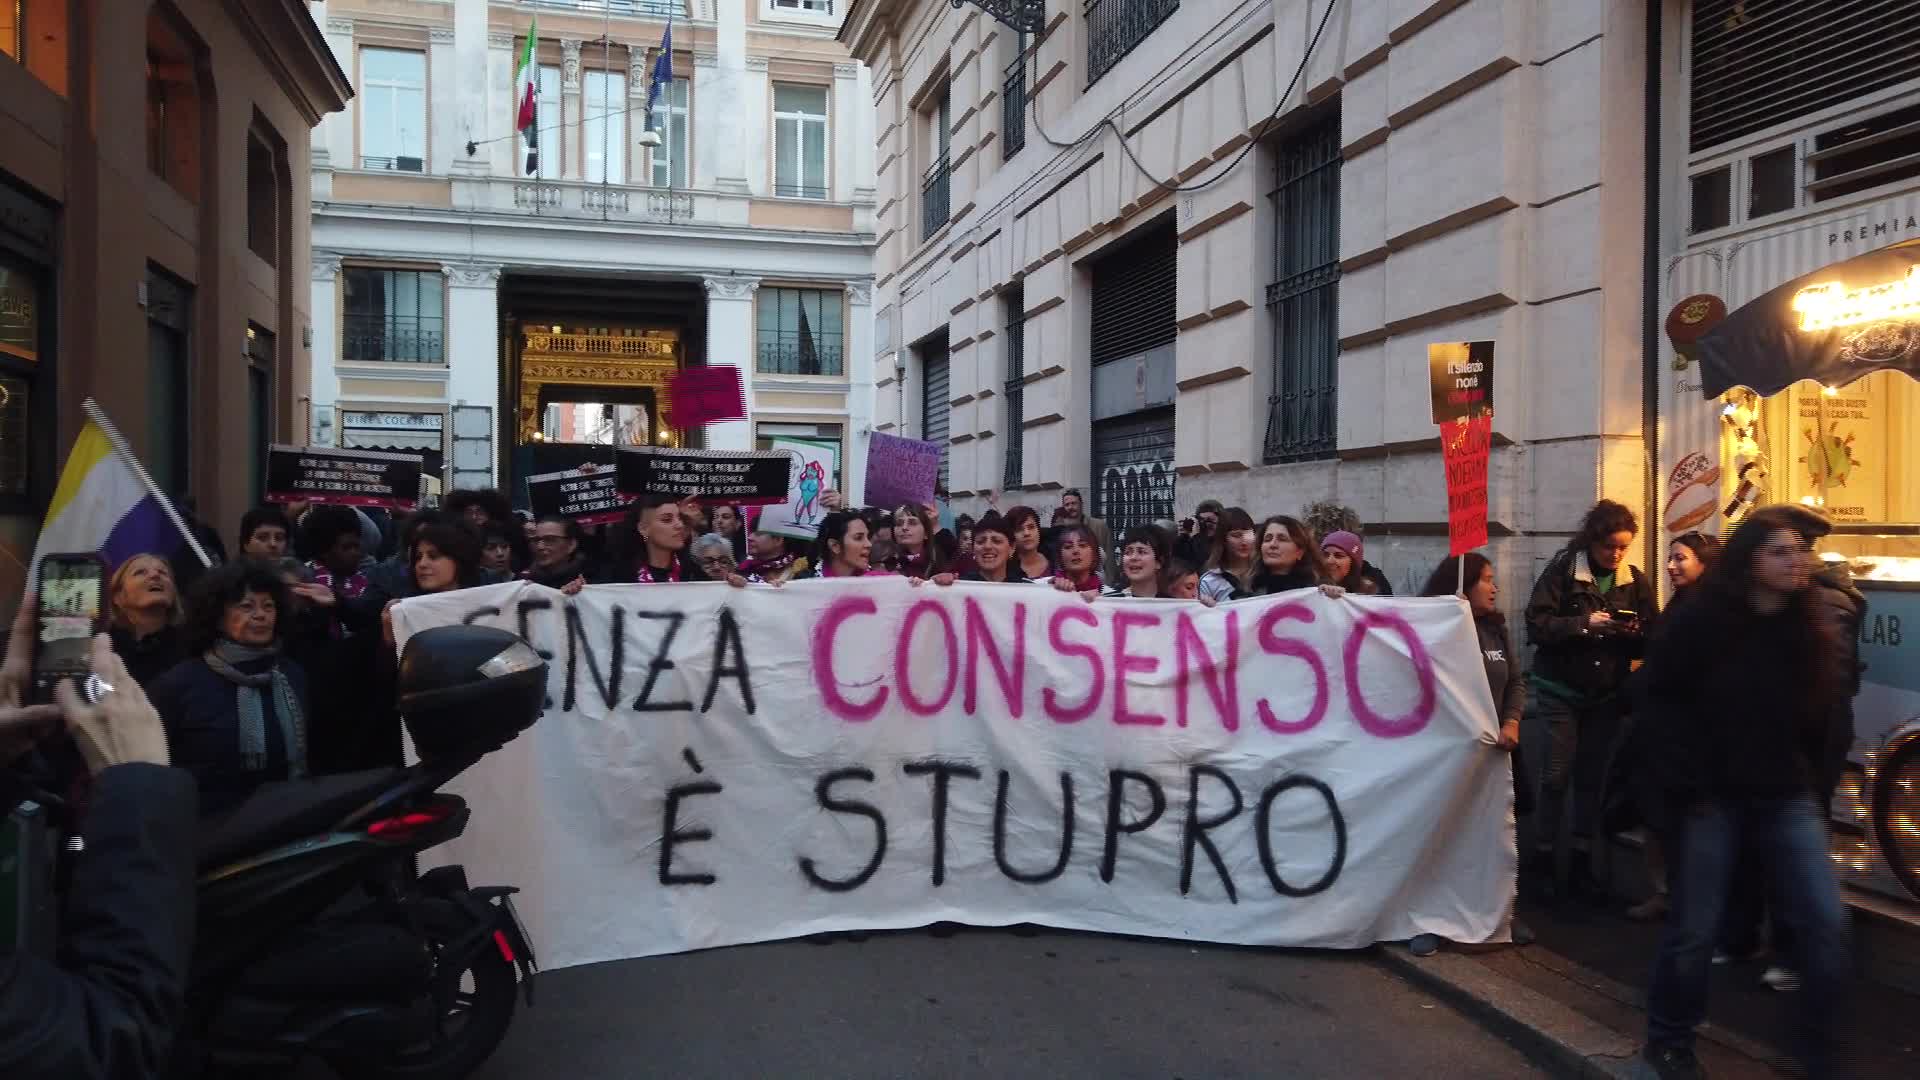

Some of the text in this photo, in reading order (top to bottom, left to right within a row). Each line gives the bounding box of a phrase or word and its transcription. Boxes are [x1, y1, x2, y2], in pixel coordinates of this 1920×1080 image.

[1828, 215, 1917, 247] PREMIA
[385, 415, 441, 426] COCKTAILS
[1861, 613, 1902, 646] LAB
[462, 593, 1437, 739] ENZA CONSENSO
[658, 746, 1347, 906] È STUPRO
